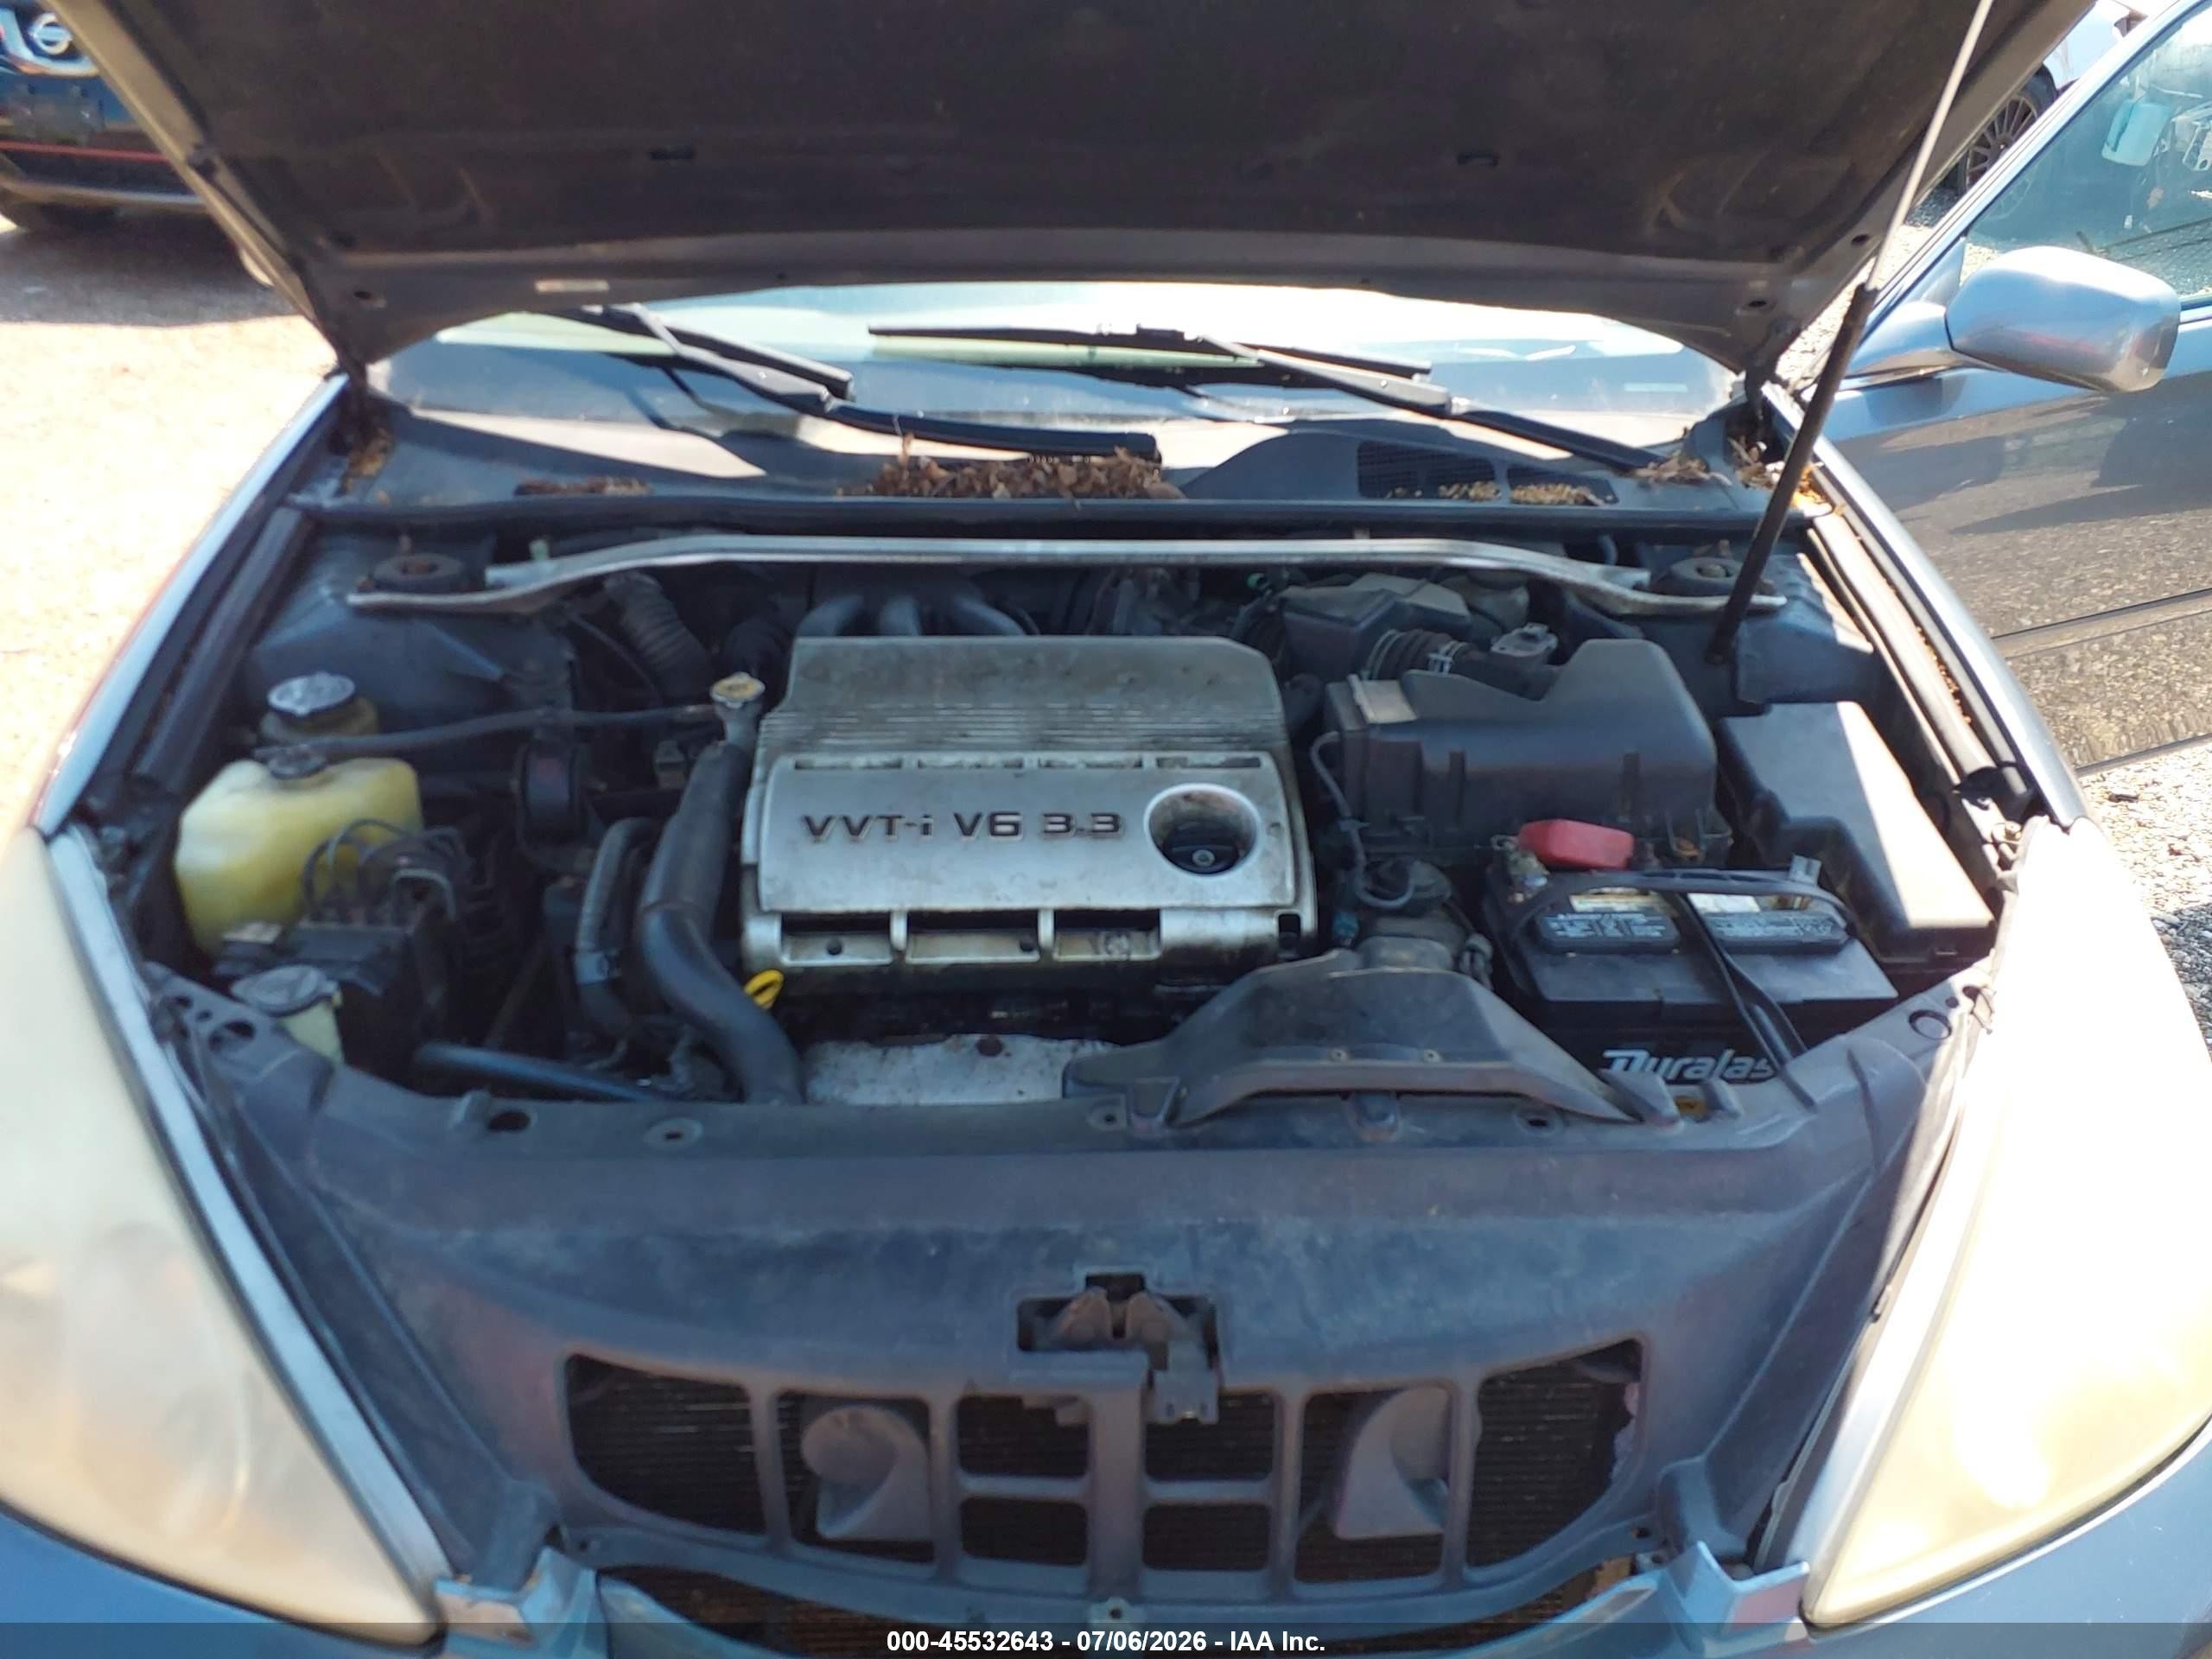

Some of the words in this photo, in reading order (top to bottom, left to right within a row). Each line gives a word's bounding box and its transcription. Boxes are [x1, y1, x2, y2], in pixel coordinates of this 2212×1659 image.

[802, 813, 935, 842] VVT-i
[953, 811, 1022, 841] V6
[1042, 811, 1122, 838] 3.3
[1602, 1048, 1777, 1081] Duralas
